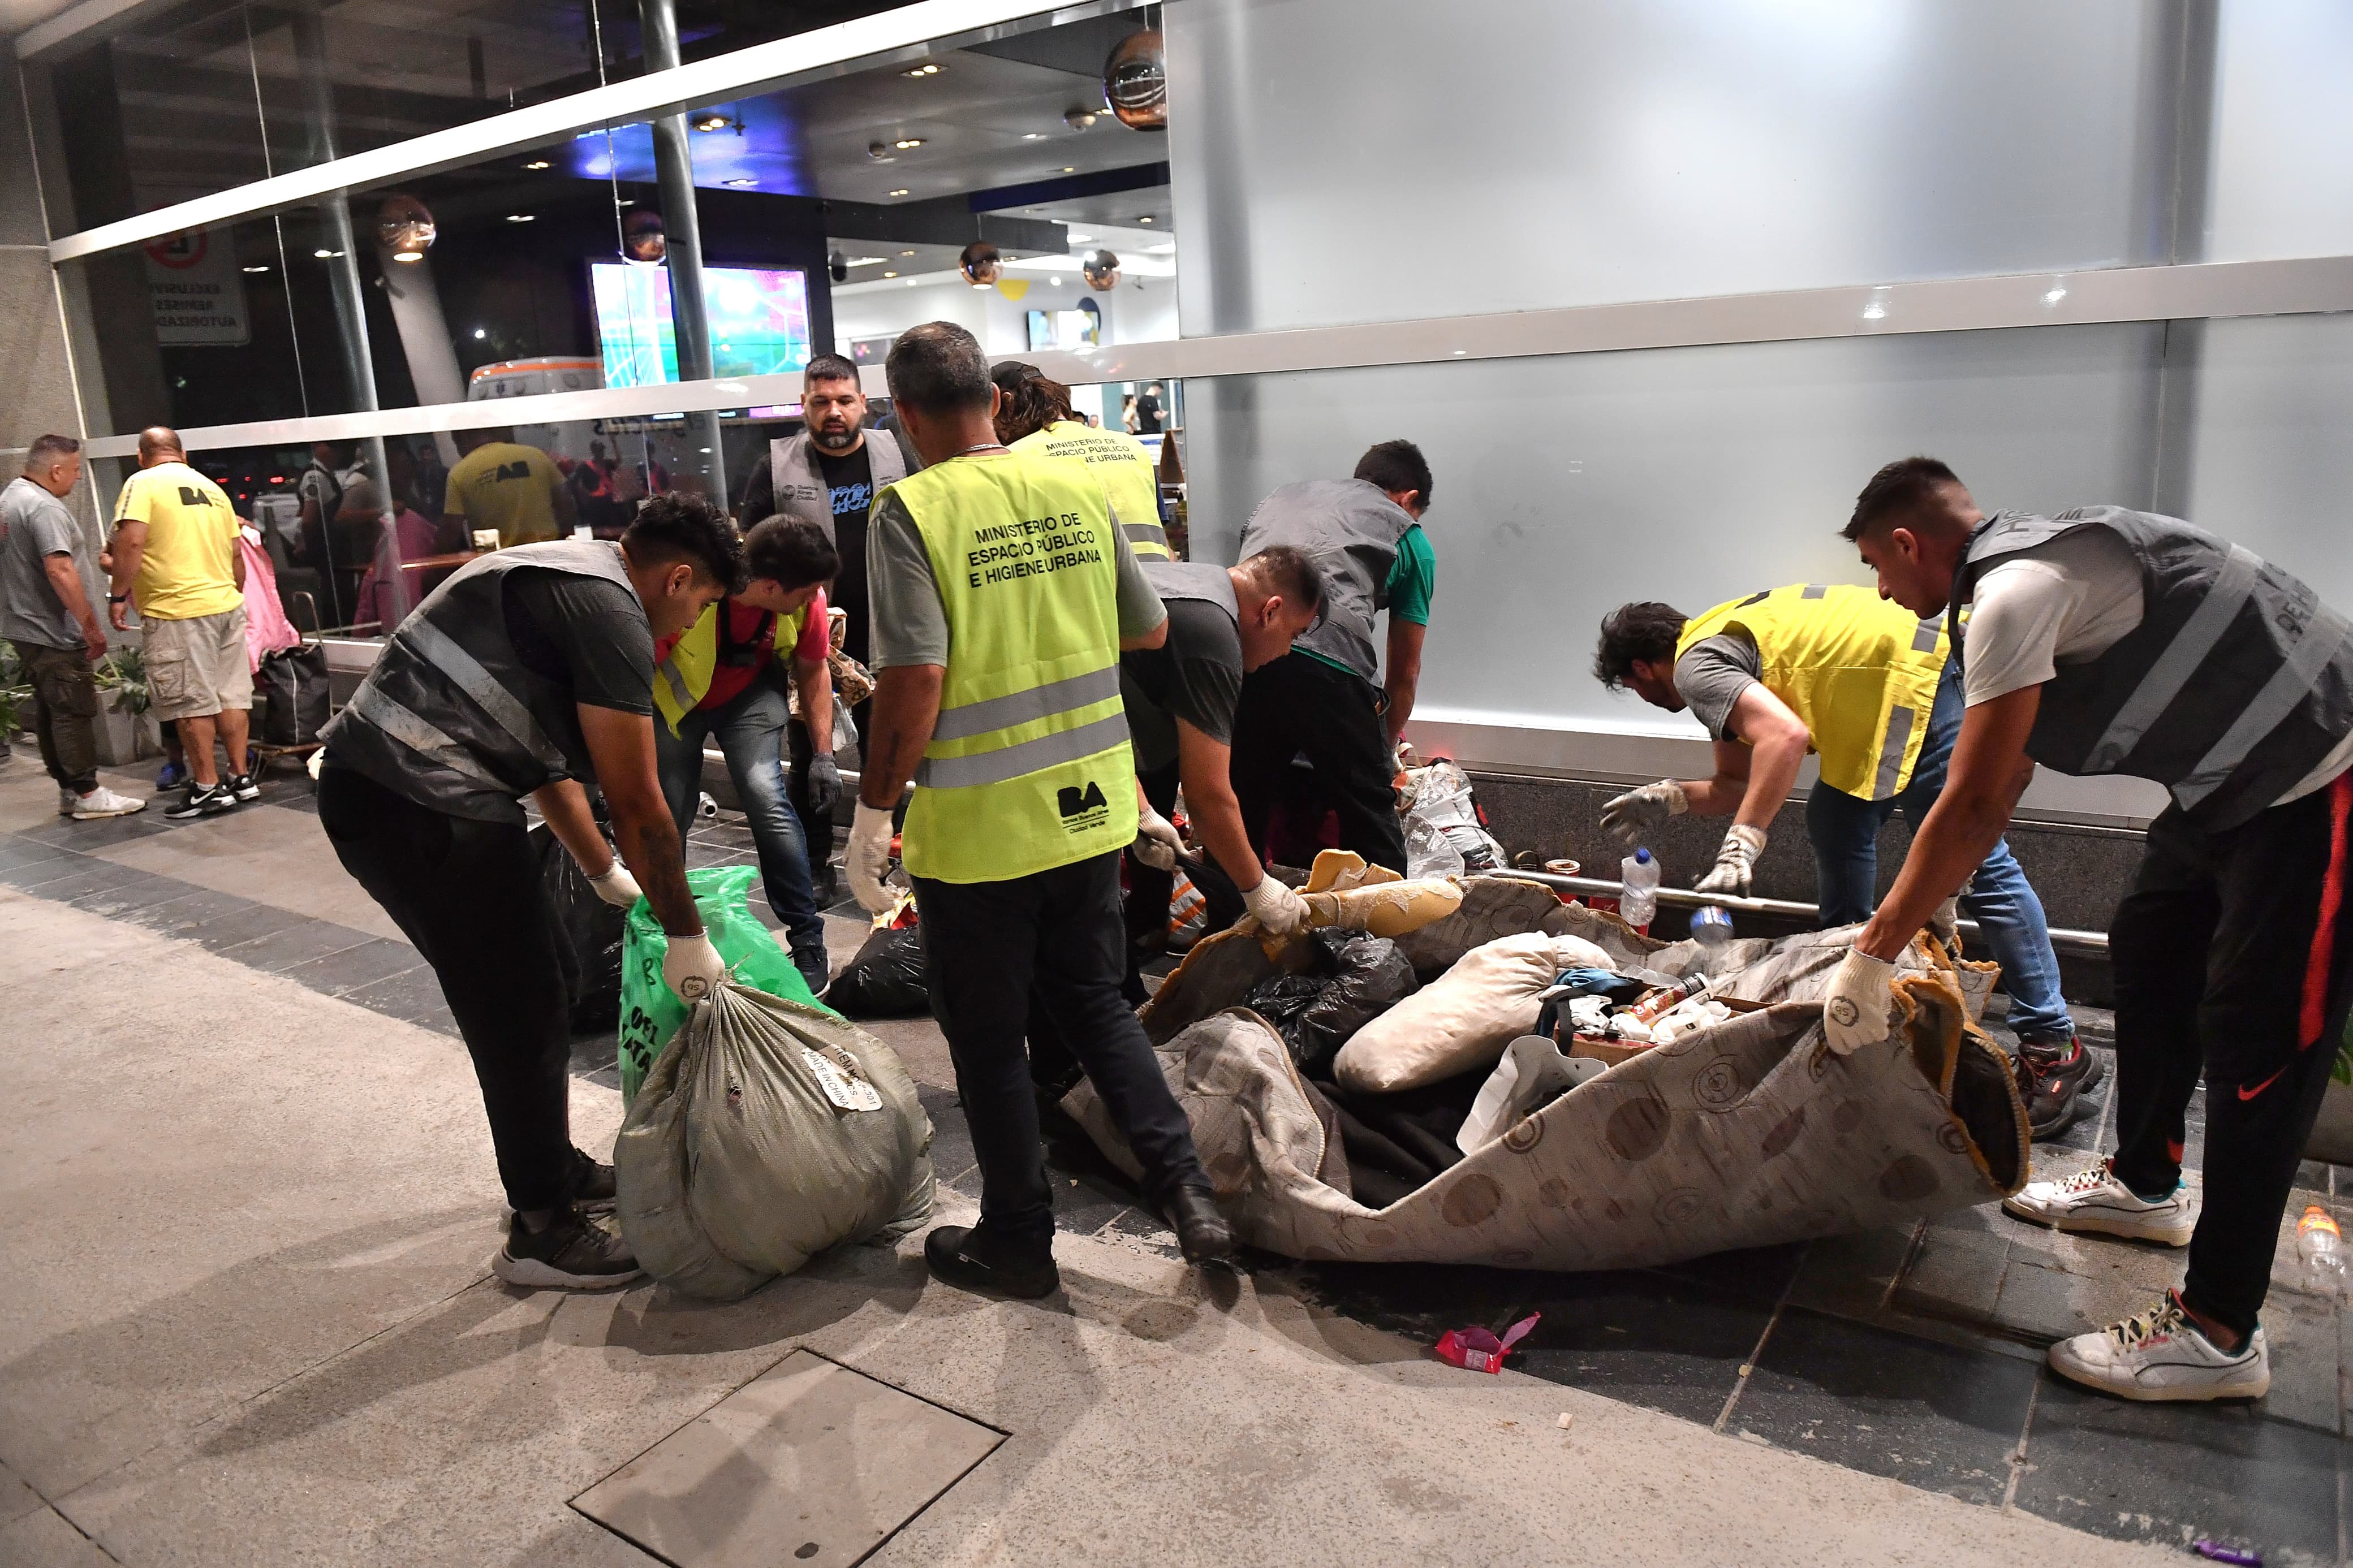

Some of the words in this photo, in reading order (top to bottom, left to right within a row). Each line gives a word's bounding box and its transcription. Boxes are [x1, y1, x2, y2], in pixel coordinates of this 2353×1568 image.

[1044, 448, 1085, 457] SPACIO
[1088, 445, 1130, 454] PÚBLICO
[1046, 439, 1102, 451] MINISTERIO
[1097, 453, 1137, 463] URBANA
[975, 517, 1057, 543] MINISTERIO
[1061, 513, 1081, 527] DE
[968, 542, 1034, 567] ESPACIO
[1036, 530, 1094, 553] PÚBLICO
[969, 572, 981, 588] E
[807, 1051, 827, 1073] MADE
[828, 1082, 849, 1107] CHINA
